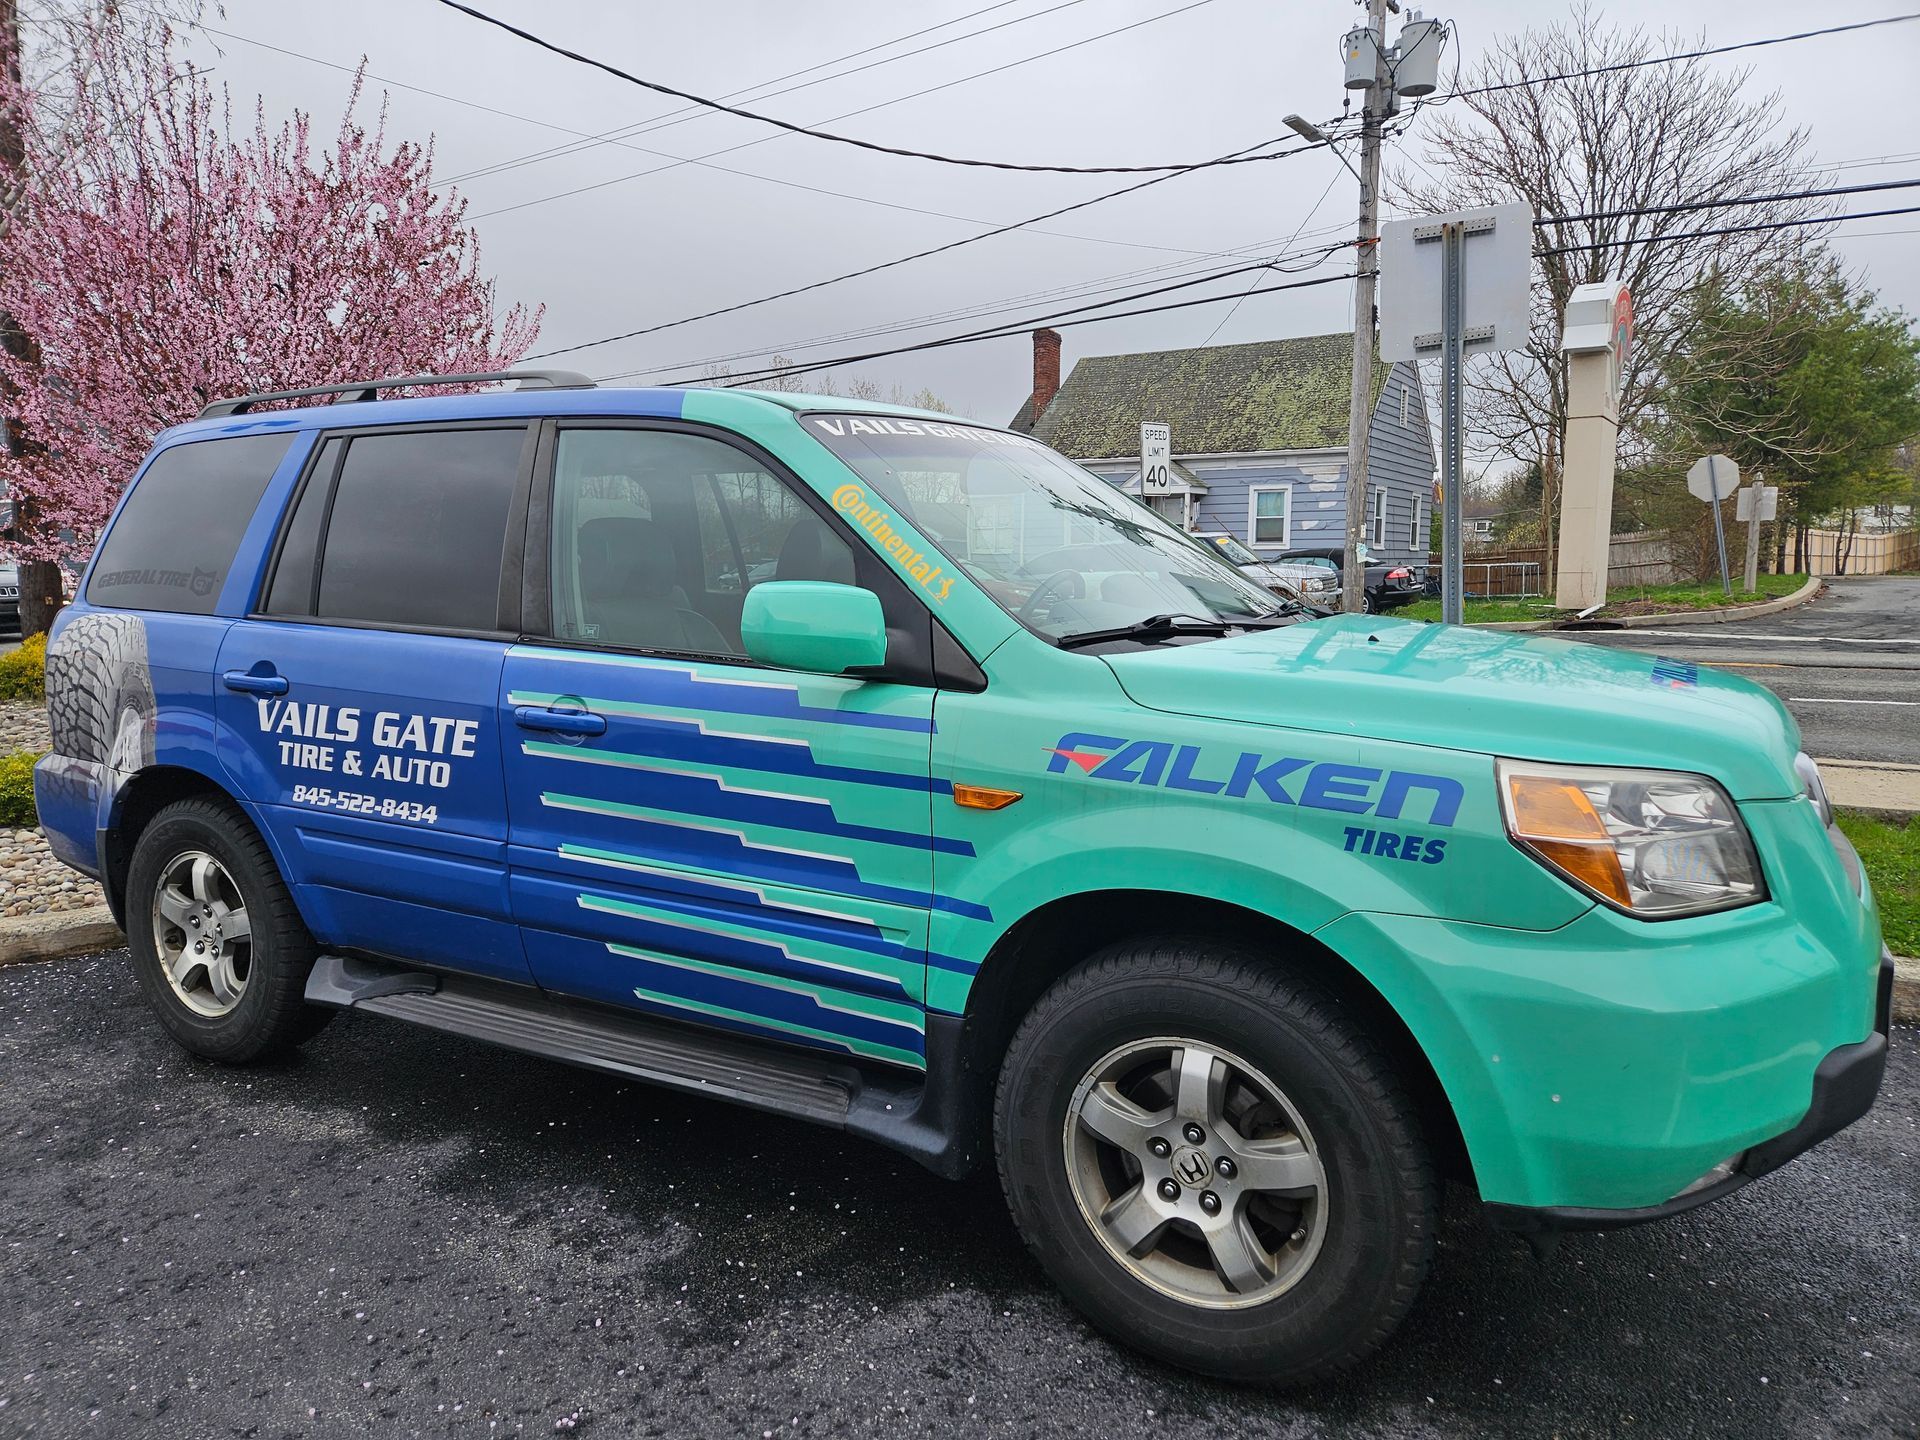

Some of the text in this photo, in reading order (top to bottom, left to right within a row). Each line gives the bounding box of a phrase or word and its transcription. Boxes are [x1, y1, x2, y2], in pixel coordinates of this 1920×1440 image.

[815, 419, 926, 436] VAILS
[922, 424, 998, 443] GATE
[1145, 429, 1167, 440] SPEED
[1148, 446, 1164, 457] LIMIT
[1146, 465, 1167, 487] 40
[832, 484, 942, 588] Continental
[98, 569, 157, 588] GENERAL
[157, 570, 191, 587] TIRE
[257, 699, 478, 758] VAILS GATE
[278, 741, 450, 788] TIRE & AUTO
[1043, 732, 1465, 828] FALKEN
[292, 785, 438, 824] 845-522-8434
[1343, 826, 1448, 865] TIRES
